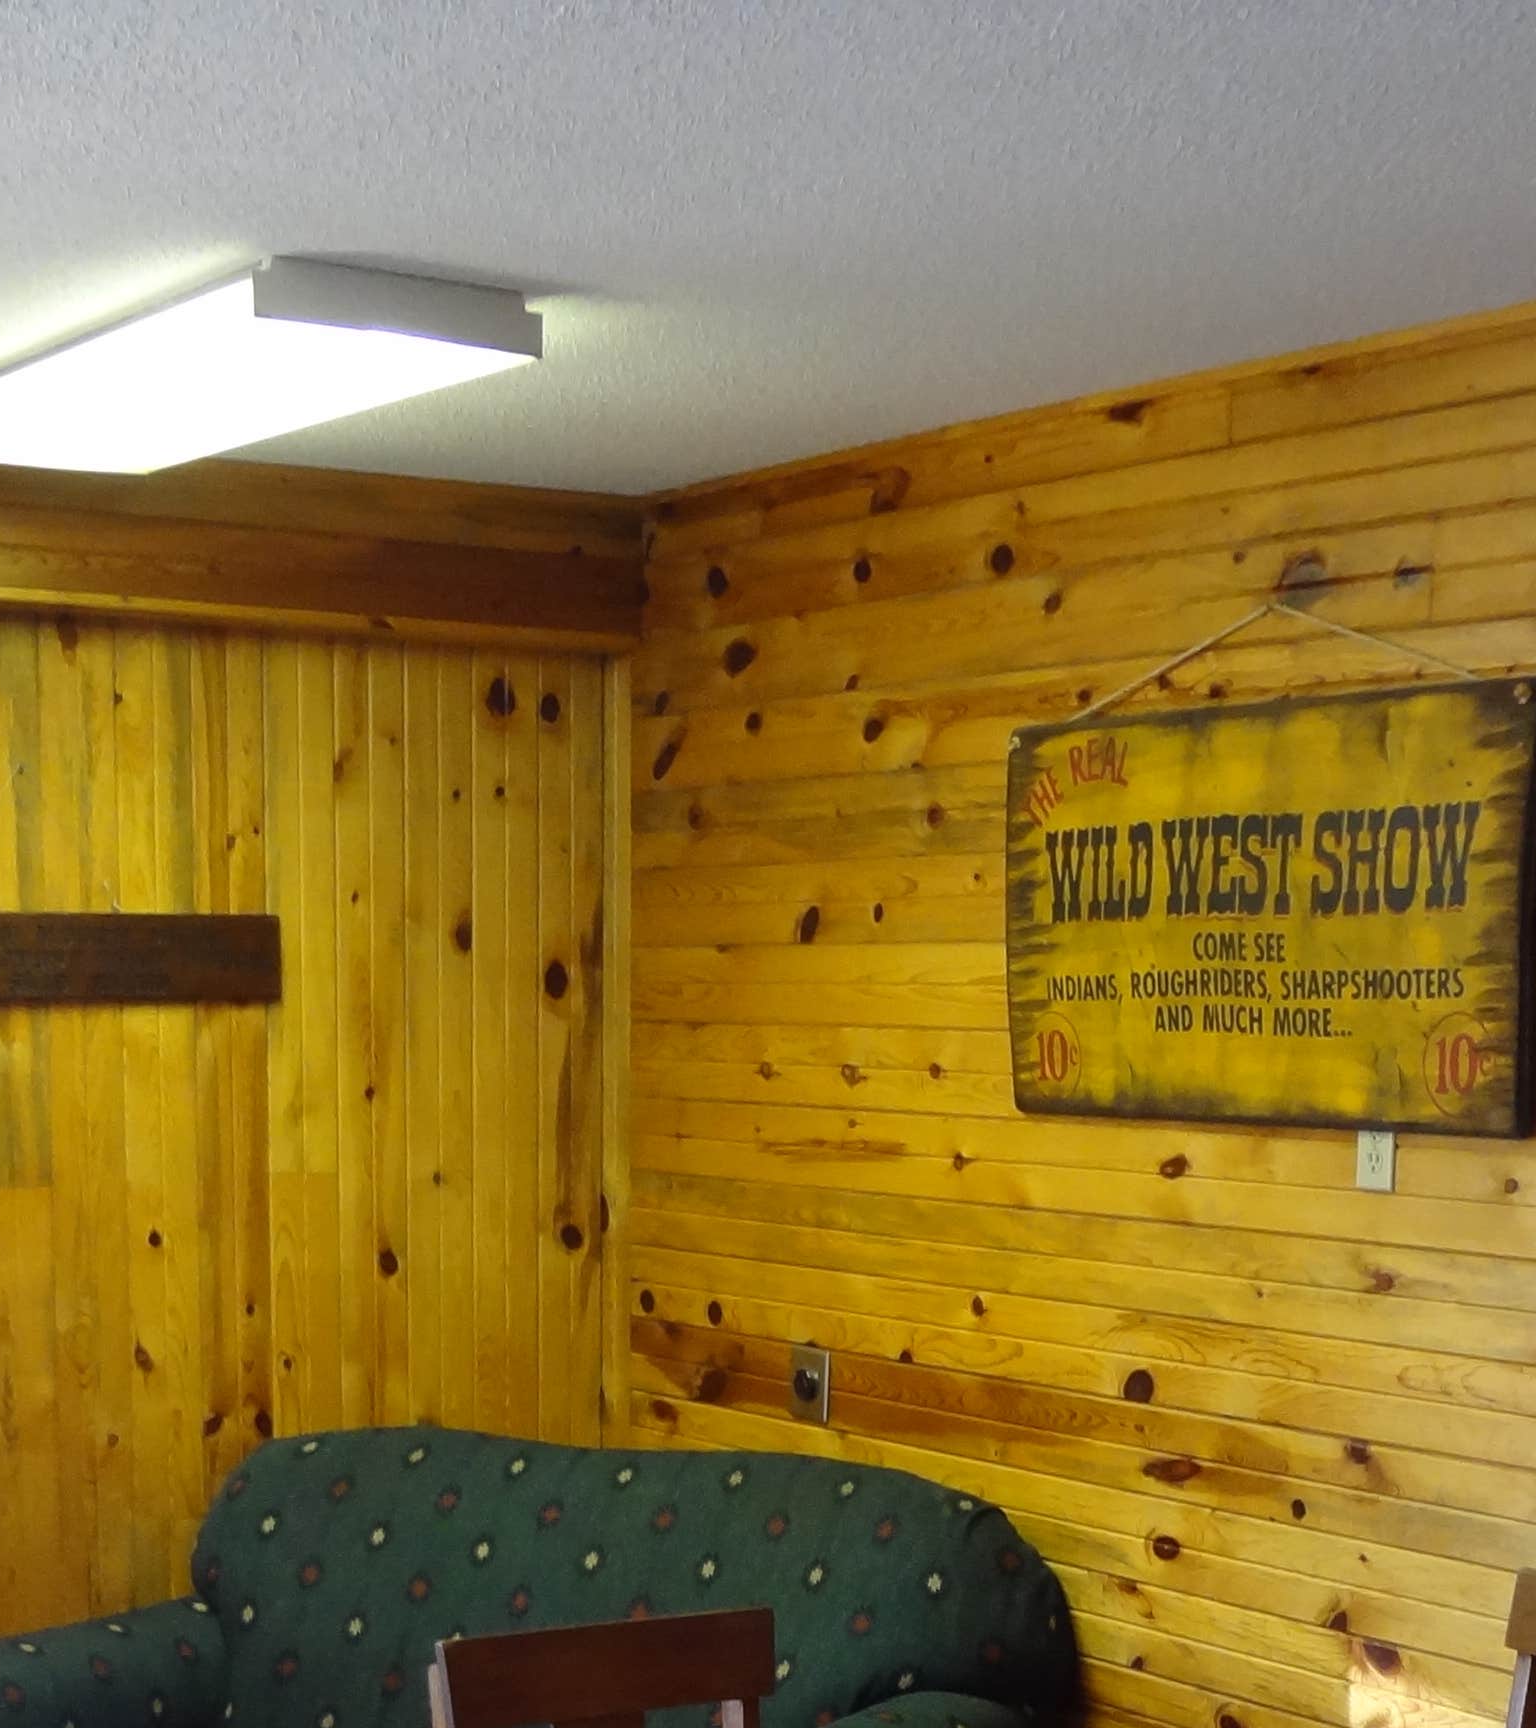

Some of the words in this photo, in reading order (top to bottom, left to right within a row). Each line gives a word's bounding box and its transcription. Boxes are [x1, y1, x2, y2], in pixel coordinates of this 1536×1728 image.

[1024, 766, 1061, 828] THE
[1069, 736, 1129, 788] REAL
[1045, 822, 1153, 924] WILD
[1162, 813, 1303, 918] WEST
[1312, 801, 1481, 918] SHOW
[1192, 932, 1247, 962] COME
[1253, 933, 1286, 963] SEE
[1047, 971, 1123, 1003] INDIANS,
[1130, 970, 1271, 1002] ROUGHRIDERS,
[1281, 967, 1464, 999] SHARPSHOOTERS
[1155, 1006, 1194, 1034] AND
[1202, 1006, 1263, 1036] MUCH
[1273, 1008, 1353, 1038] MORE...
